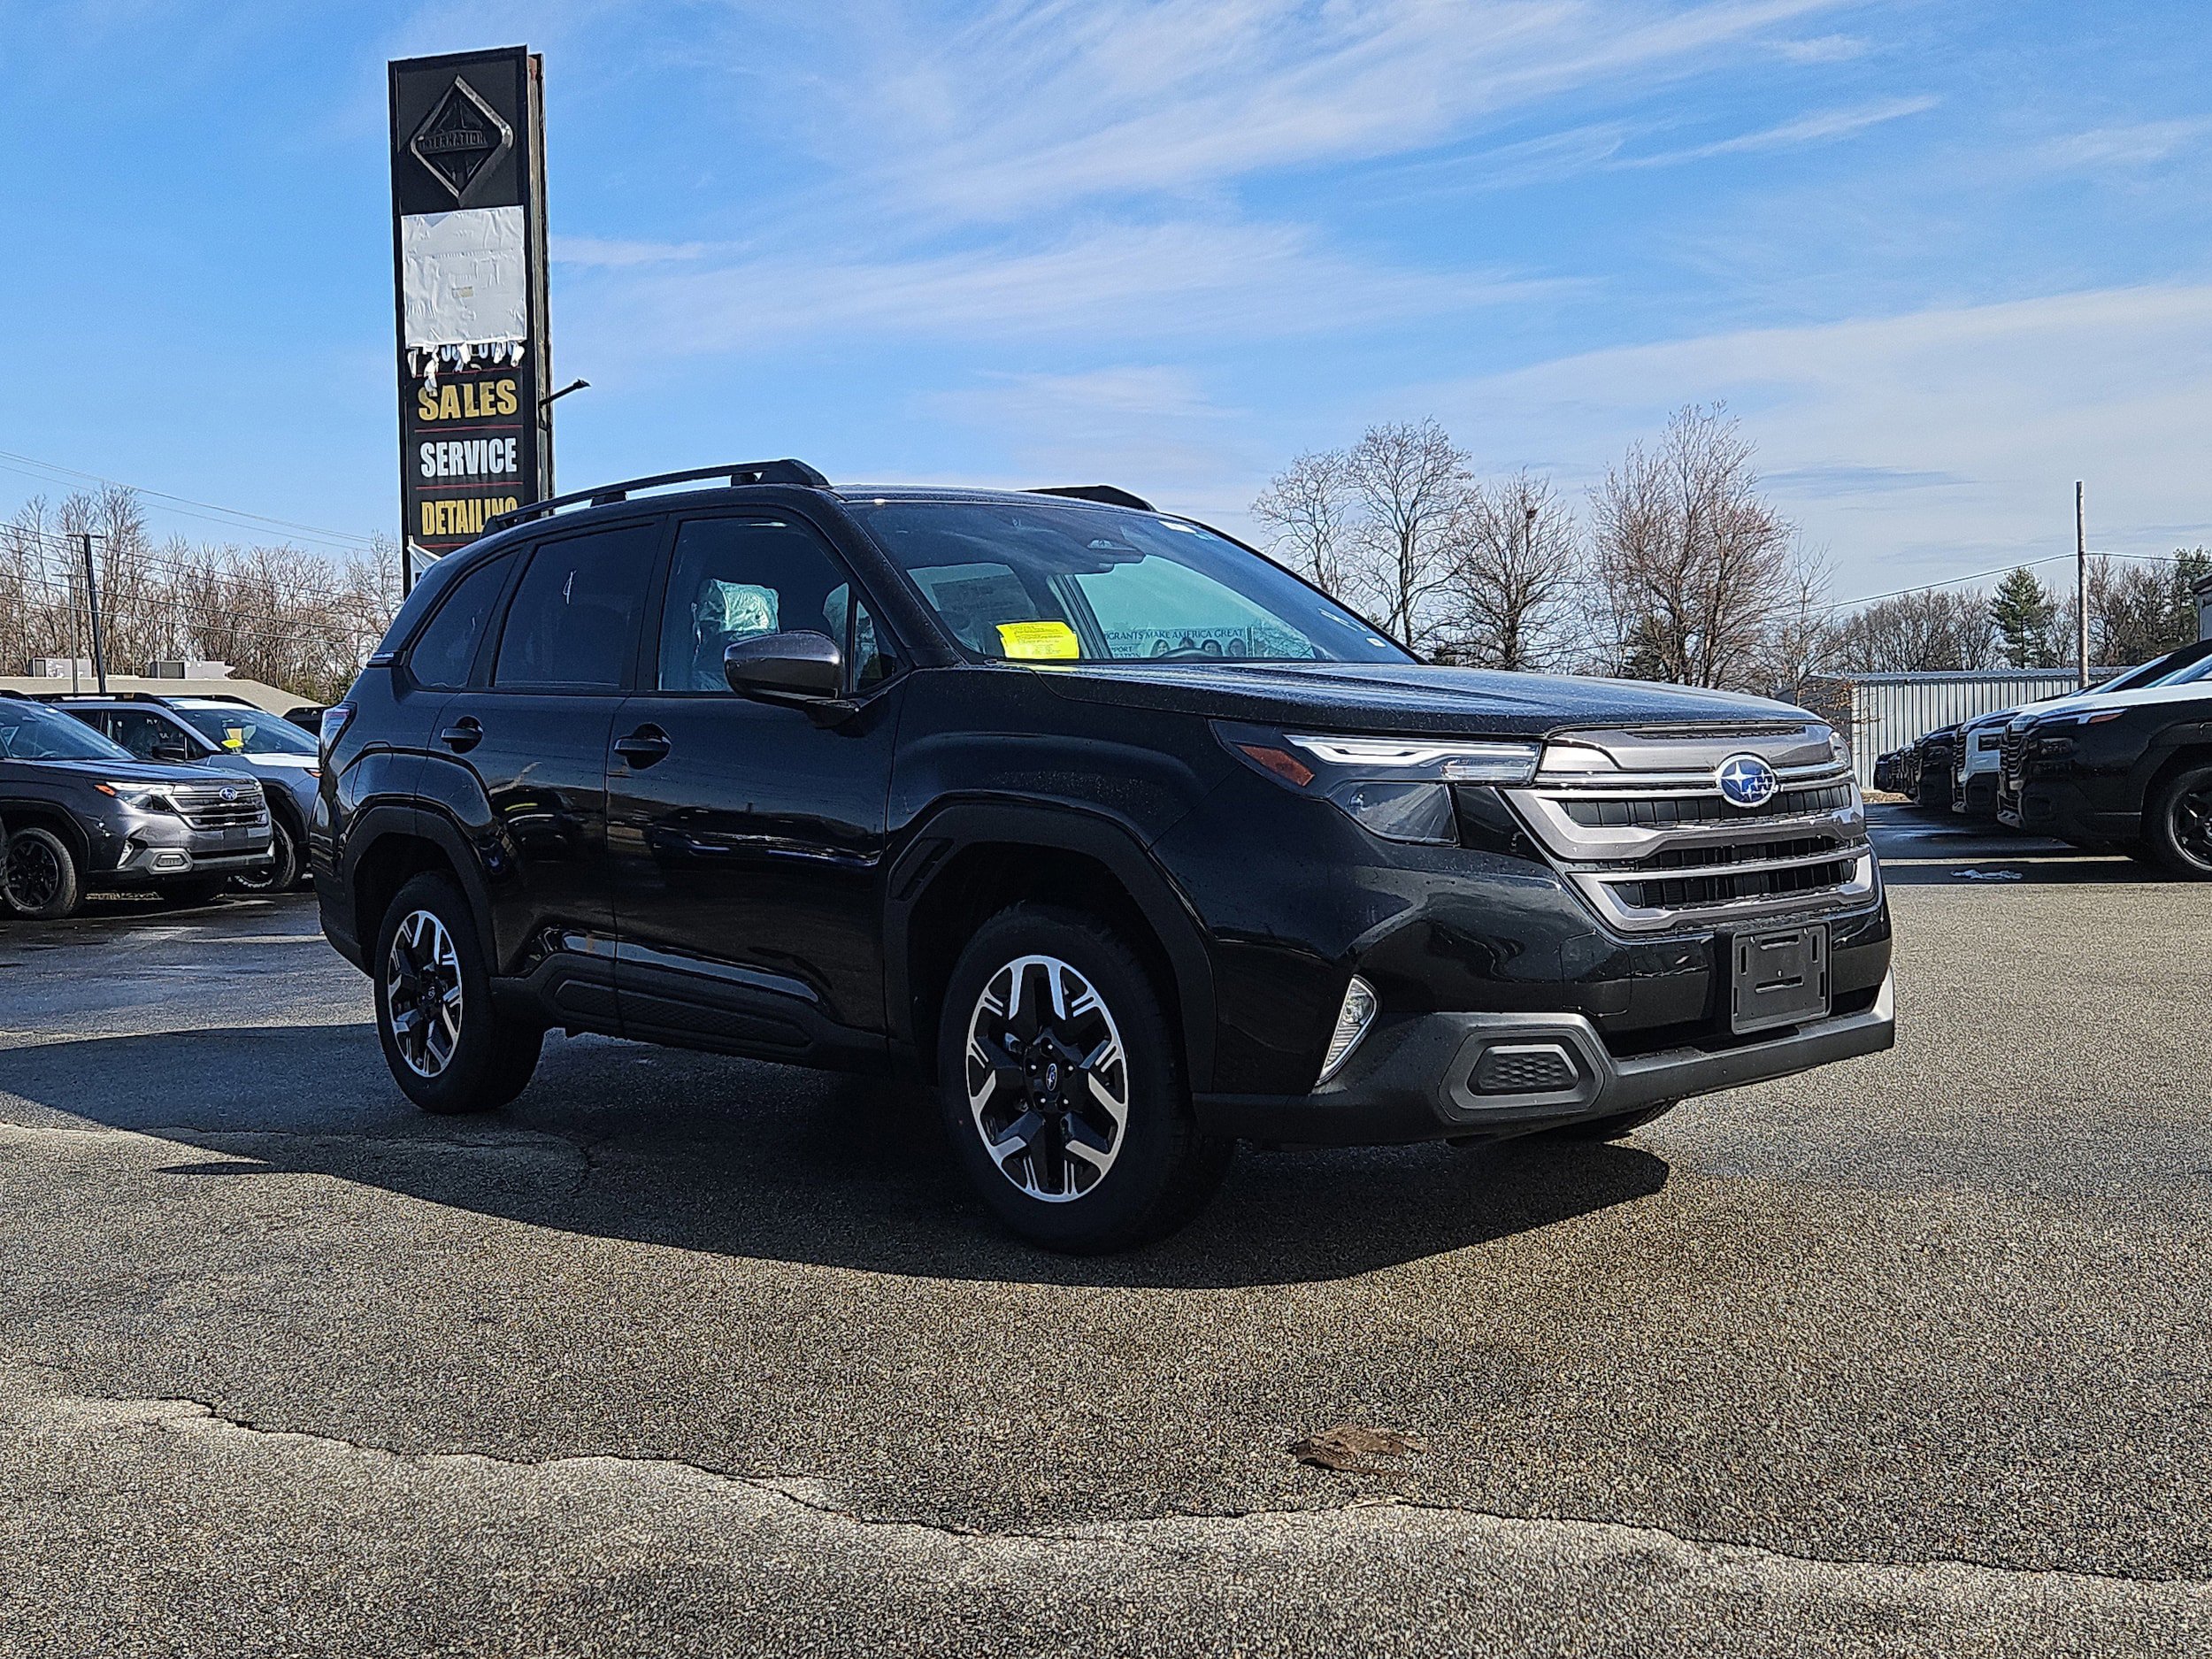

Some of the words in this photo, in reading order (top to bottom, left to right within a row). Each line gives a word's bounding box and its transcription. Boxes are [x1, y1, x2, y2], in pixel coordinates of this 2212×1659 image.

[418, 379, 518, 420] SALES
[420, 437, 518, 478] SERVICE
[1145, 630, 1170, 639] MAKE
[1172, 630, 1212, 639] AMERICA
[1214, 628, 1244, 638] GREAT
